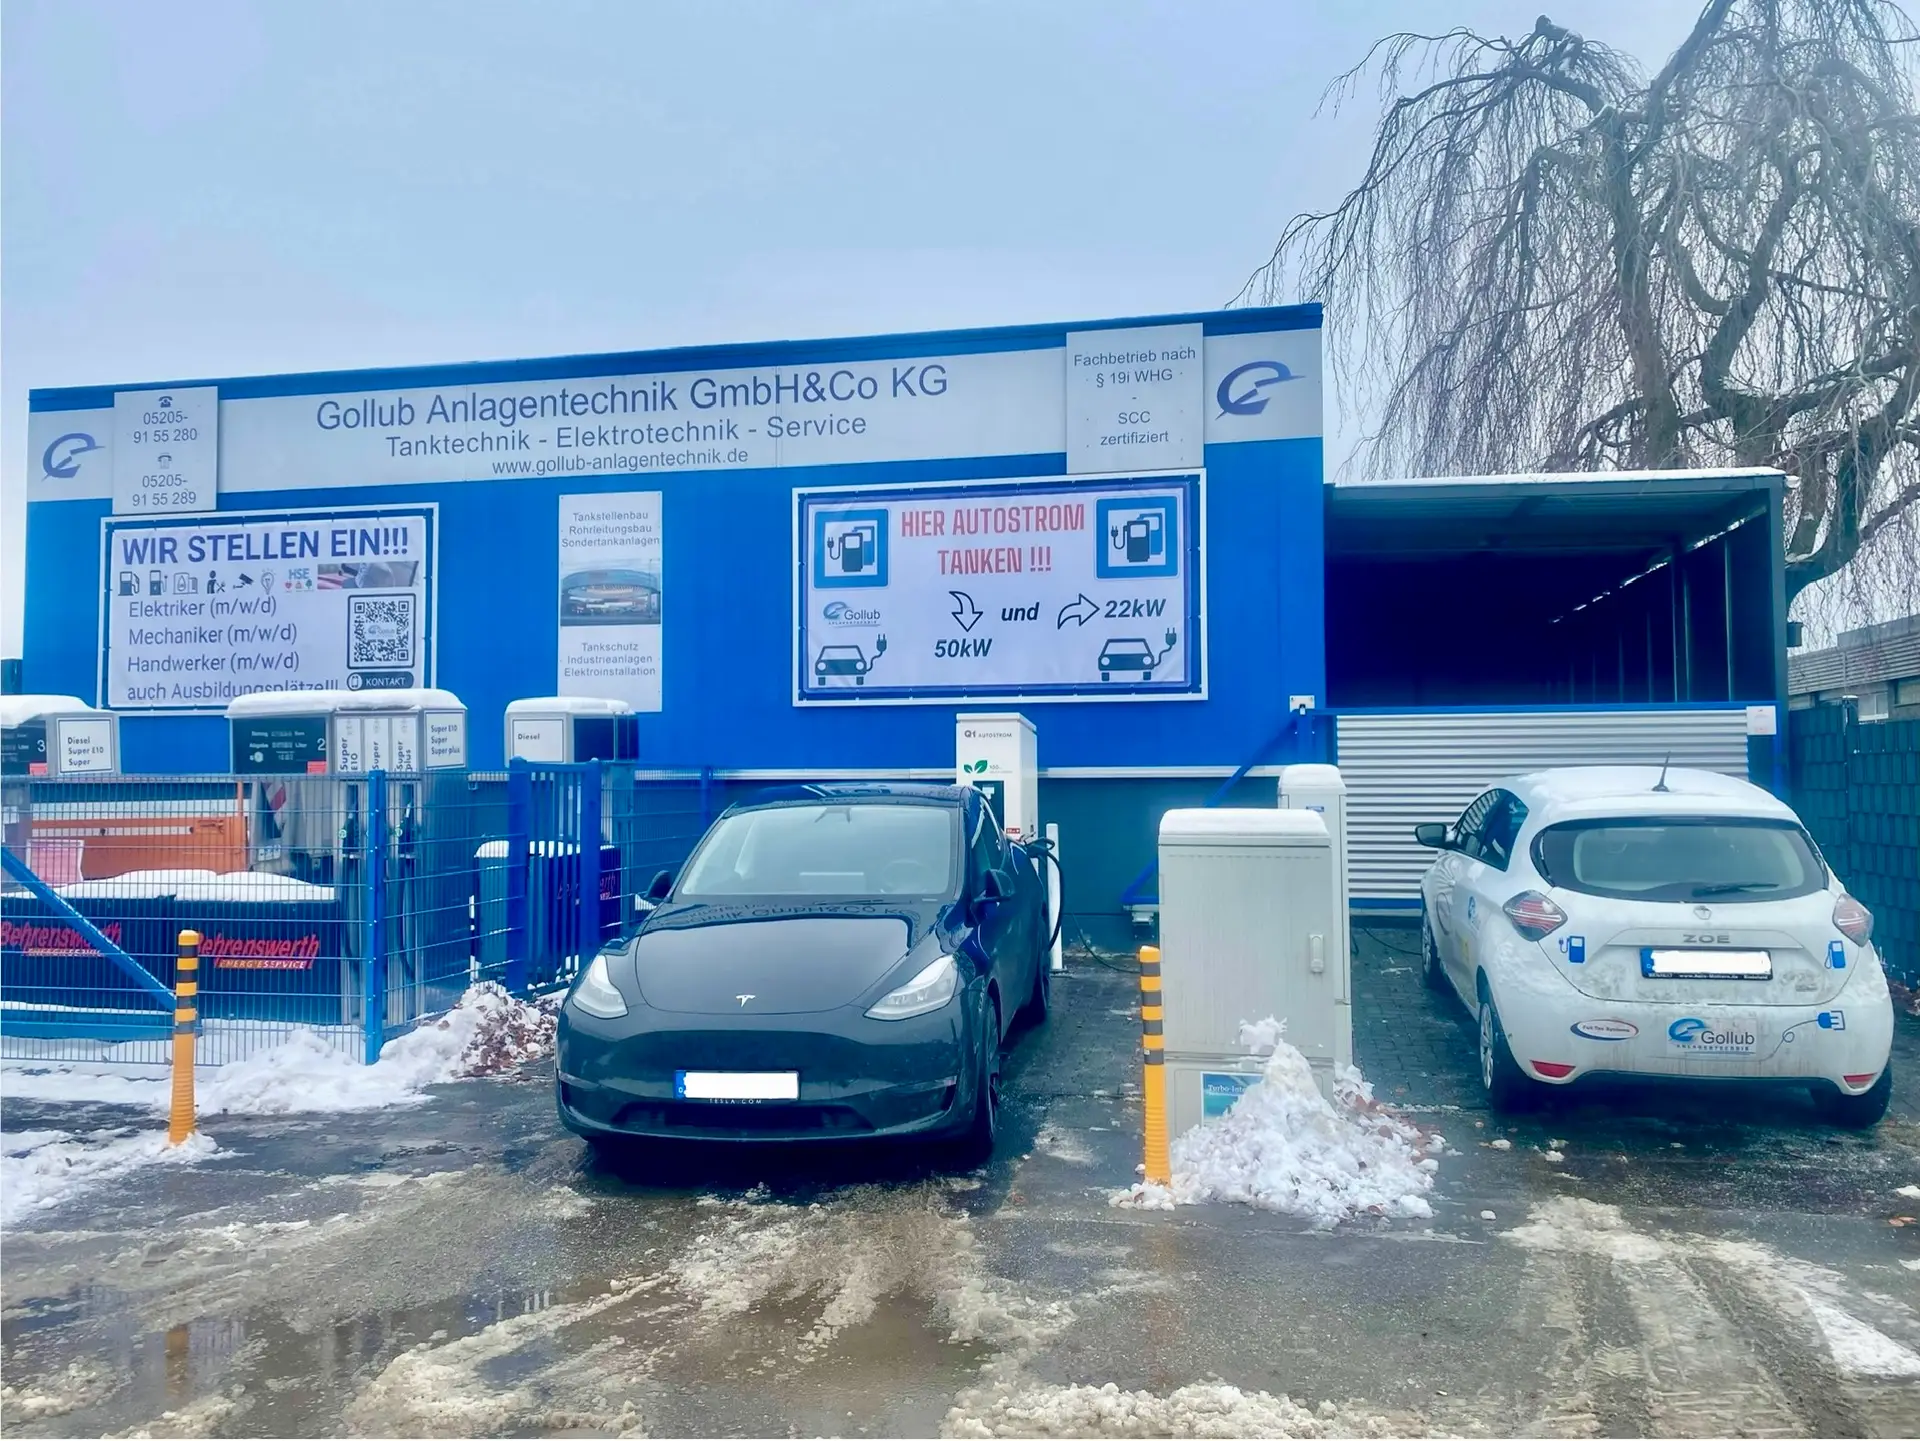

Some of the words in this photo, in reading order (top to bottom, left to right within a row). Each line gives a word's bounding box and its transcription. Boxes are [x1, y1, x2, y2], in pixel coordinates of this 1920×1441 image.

[1073, 349, 1157, 367] Fachbetrieb
[1161, 346, 1196, 361] nach
[1095, 372, 1105, 388] §
[1110, 370, 1130, 385] 19i
[1134, 368, 1173, 383] WHG
[316, 396, 416, 430] Gollub
[426, 380, 678, 428] Anlagentechnik
[689, 369, 878, 409] GmbH&Co
[891, 363, 948, 399] KG
[142, 410, 189, 425] 05205-
[1117, 410, 1151, 425] SCC
[133, 430, 148, 444] 91
[153, 429, 170, 443] 55
[173, 427, 198, 442] 280
[386, 429, 531, 458] Tanktechnik
[556, 418, 739, 449] Elektrotechnik
[766, 413, 867, 439] Service
[1100, 429, 1170, 447] zertifiziert
[492, 447, 749, 476] www.gollub-anlagentechnik.de
[141, 473, 188, 488] 05205-
[132, 493, 147, 507] 91
[152, 492, 169, 505] 55
[172, 491, 197, 505] 289
[572, 511, 649, 522] Tankstellenbau
[901, 509, 946, 538] HIER
[952, 503, 1085, 536] AUTOSTROM
[569, 524, 652, 536] Rohrleitungsbau
[122, 536, 178, 565] WIR
[187, 530, 320, 563] STELLEN
[331, 526, 408, 558] EIN!!!
[561, 536, 661, 549] Sondertankanlagen
[937, 547, 1022, 576] TANKEN
[1030, 545, 1052, 572] !!!
[288, 567, 310, 581] HSE
[128, 599, 206, 618] Elektriker
[209, 595, 277, 619] (m/w/d)
[1001, 601, 1040, 622] und
[1104, 598, 1167, 619] 22kW
[844, 609, 881, 621] Gollub
[128, 625, 224, 646] Mechaniker
[227, 622, 298, 647] (m/w/d)
[581, 641, 639, 652] Tankschutz
[934, 637, 993, 658] 50kW
[127, 653, 227, 673] Handwerker
[230, 650, 300, 674] (m/w/d)
[567, 653, 653, 665] Industrieanlagen
[564, 665, 656, 678] Elektroinstallation
[365, 675, 406, 687] KONTAKT
[127, 682, 167, 701] auch
[430, 724, 448, 734] Super
[517, 732, 541, 740] Diesel
[36, 738, 46, 753] 3
[67, 735, 91, 745] Diesel
[316, 737, 327, 752] 2
[430, 736, 448, 745] Super
[68, 746, 90, 756] Super
[91, 746, 105, 754] E10
[339, 737, 350, 771] Super
[371, 741, 381, 769] Super
[396, 740, 405, 770] Super
[430, 746, 448, 755] Super
[68, 757, 91, 768] Super
[350, 752, 359, 771] E10
[404, 748, 413, 772] plus
[1, 920, 121, 948] Behrenswth
[1682, 934, 1731, 944] ZOE
[1701, 1030, 1755, 1045] Gollub
